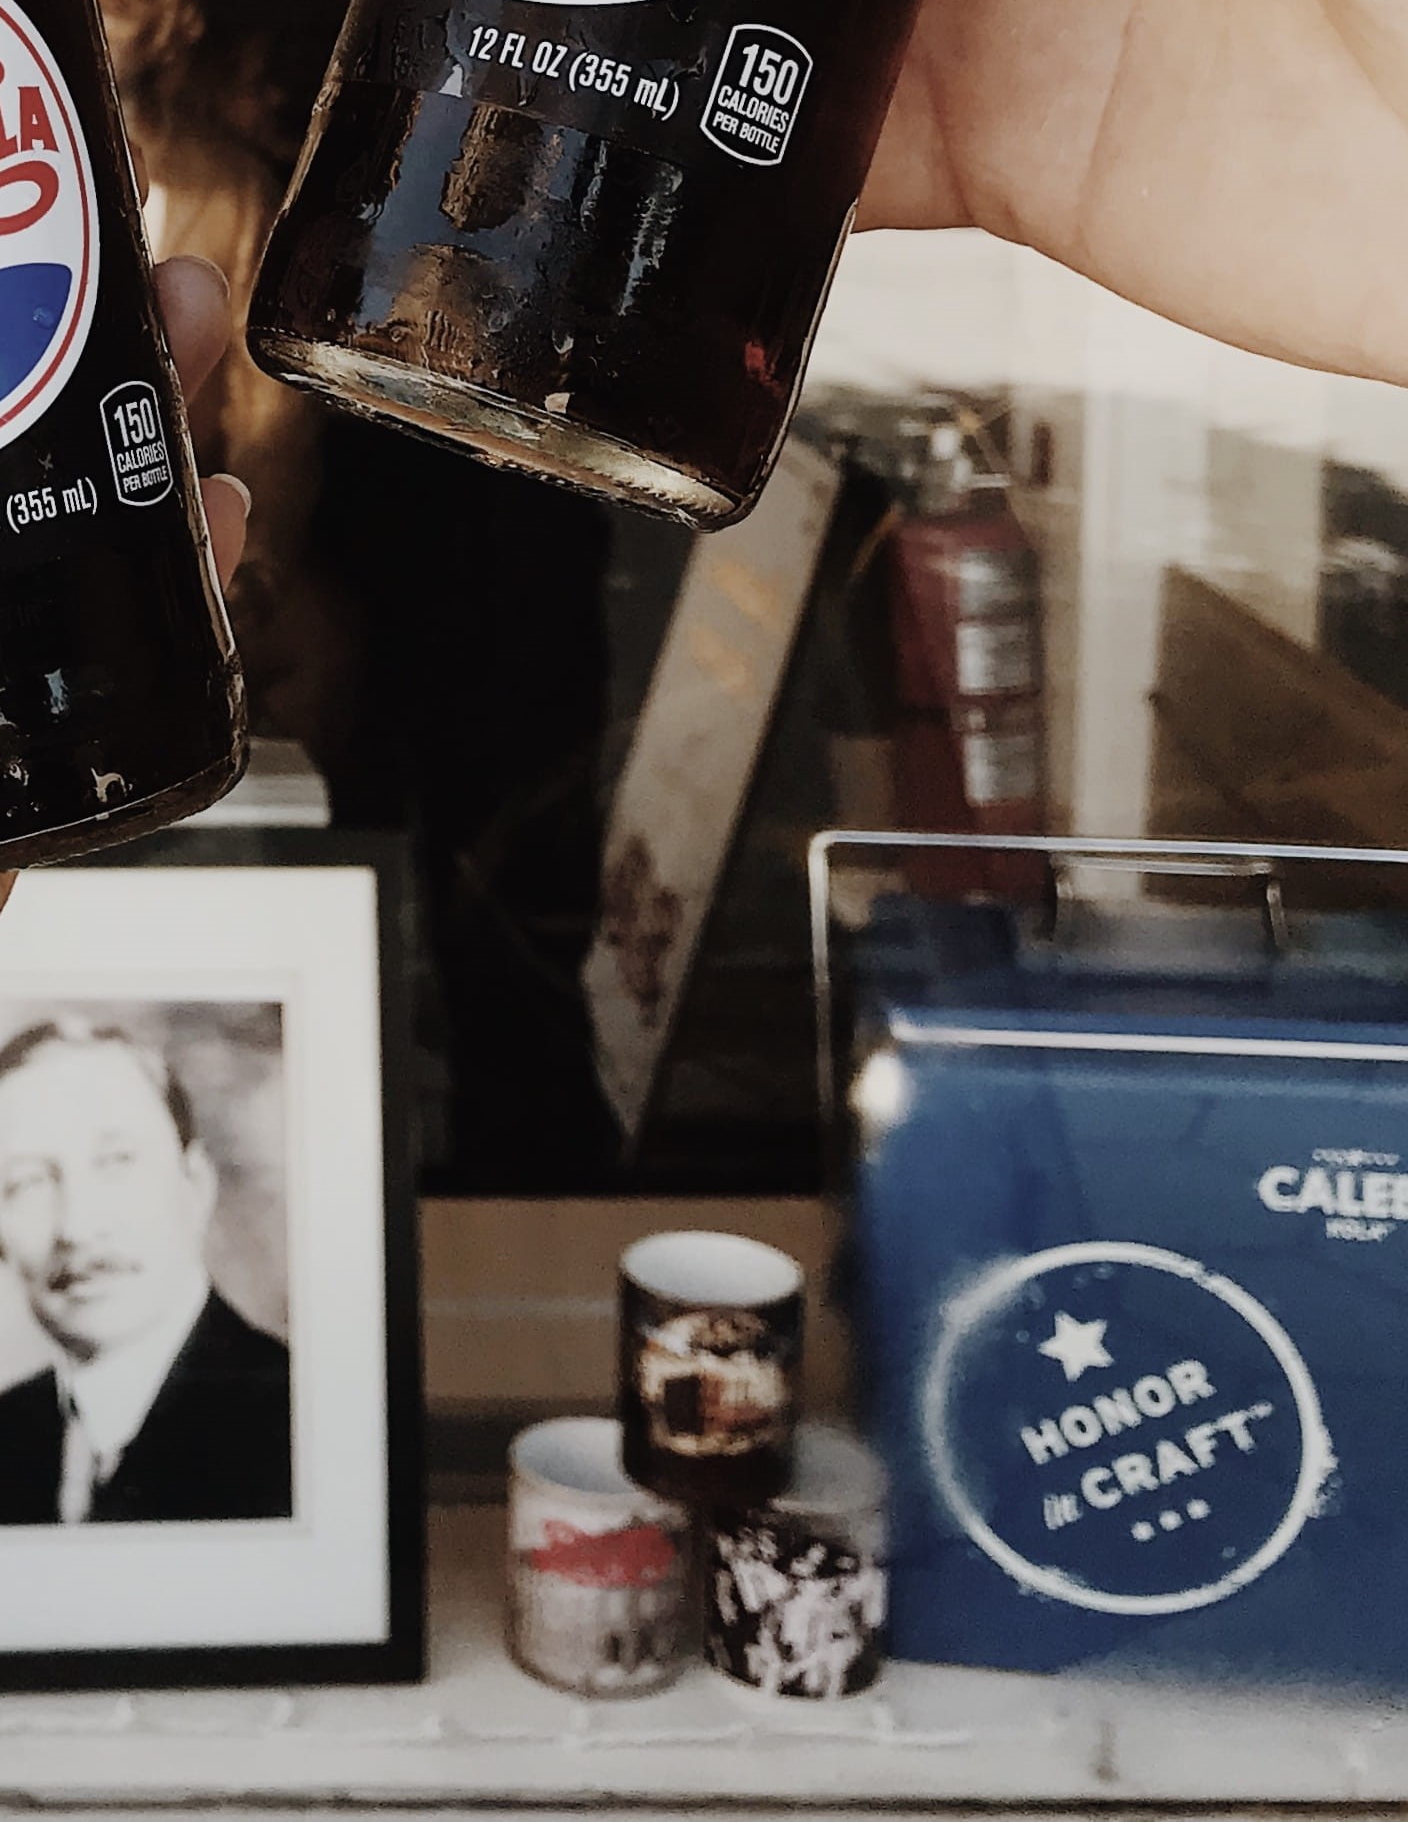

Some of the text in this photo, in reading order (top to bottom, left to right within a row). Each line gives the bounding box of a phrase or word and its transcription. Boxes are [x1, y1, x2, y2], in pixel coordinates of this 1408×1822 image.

[467, 25, 680, 122] 12 FL OZ (355 mL)
[738, 43, 800, 107] 150
[712, 111, 782, 155] PER BOTTLE
[716, 84, 790, 134] CALORIES
[113, 397, 157, 448] 150
[115, 440, 165, 475] CALORIES
[122, 467, 169, 494] PER BOTTLE
[6, 488, 59, 534] (355
[61, 477, 98, 516] mL)
[1020, 1358, 1217, 1466] HONOR
[1080, 1404, 1259, 1510] CRAFT
